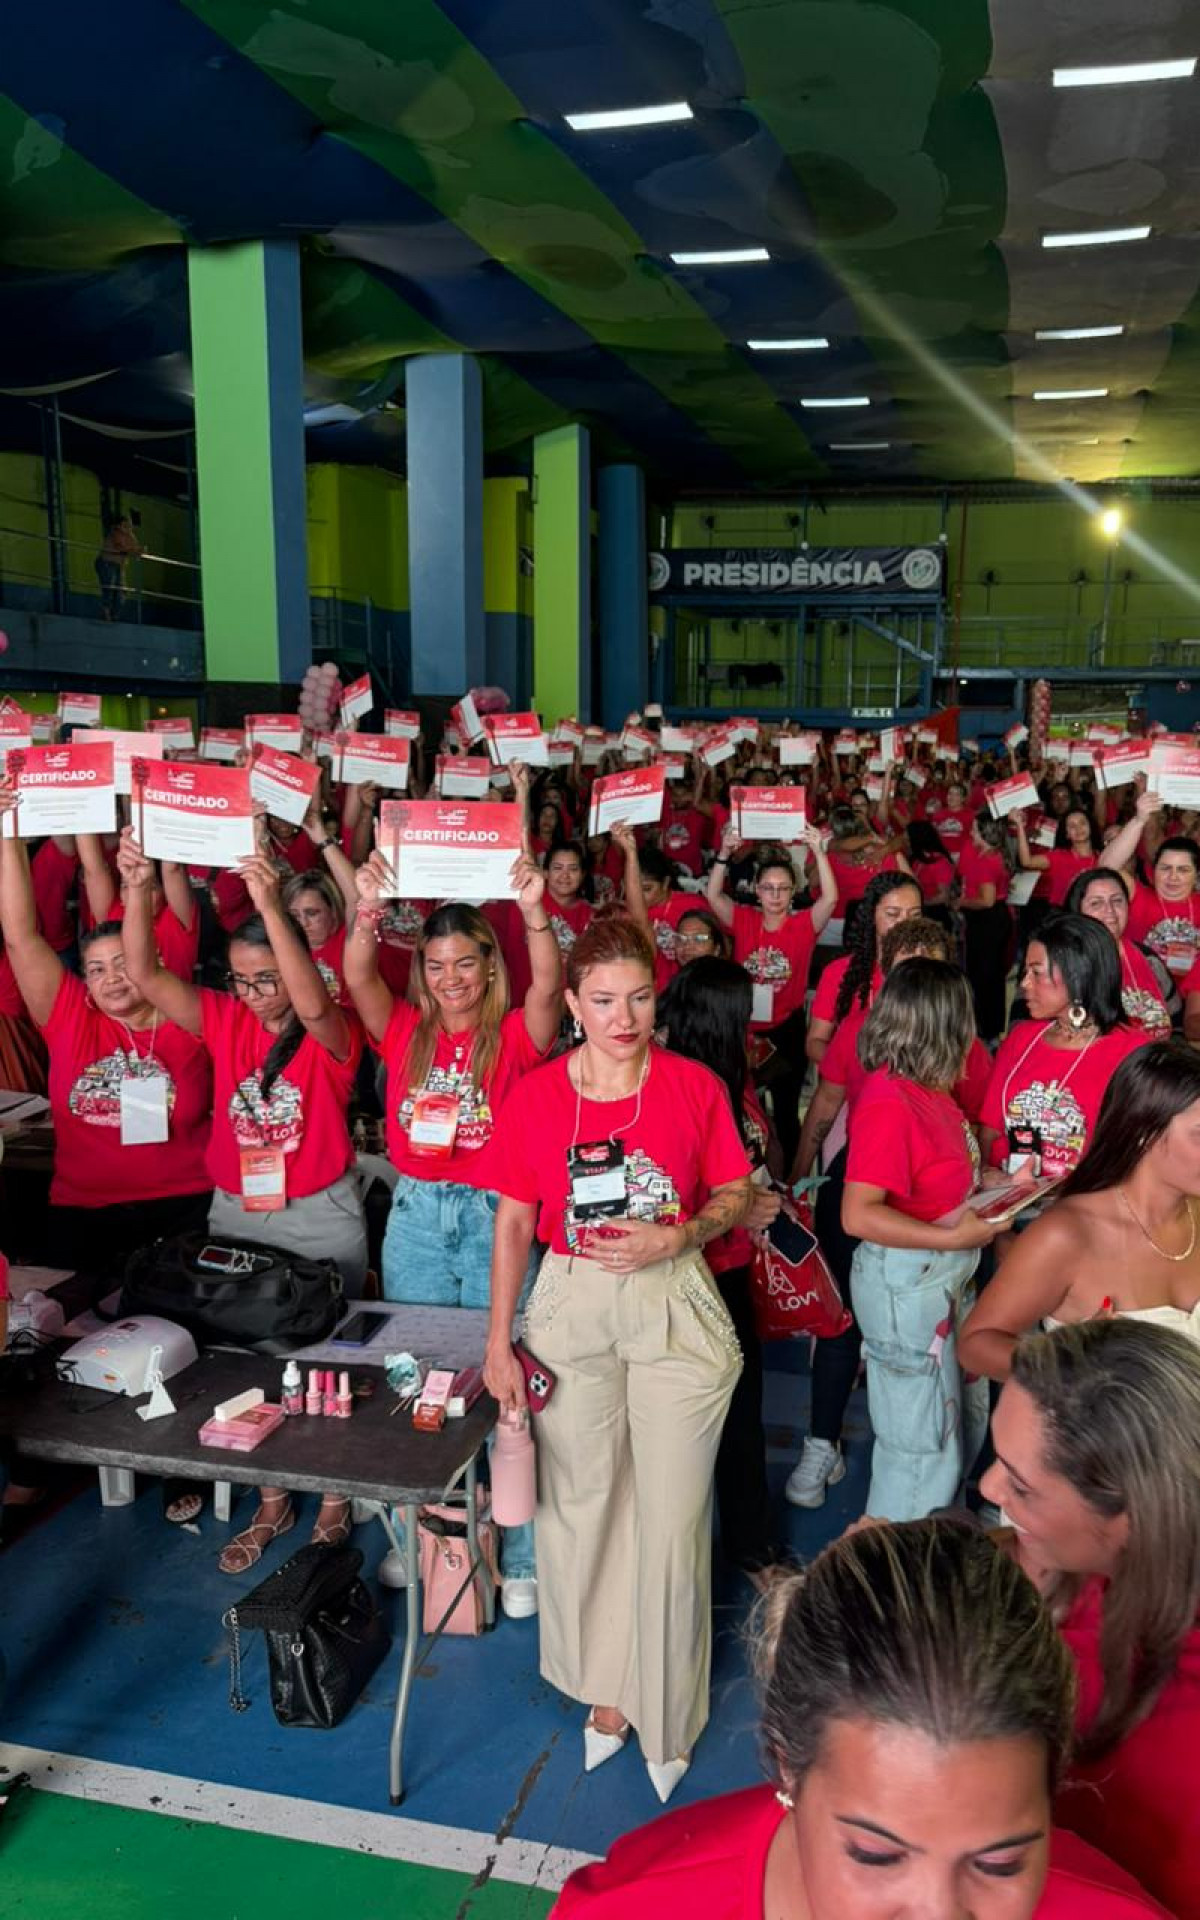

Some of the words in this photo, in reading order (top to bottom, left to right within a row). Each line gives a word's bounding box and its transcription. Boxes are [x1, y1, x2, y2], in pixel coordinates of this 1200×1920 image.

[683, 557, 885, 586] PRESIDÊNCIA
[20, 770, 96, 784] CERTIFICADO
[143, 788, 229, 808] CERTIFICADO
[403, 830, 499, 842] CERTIFICADO
